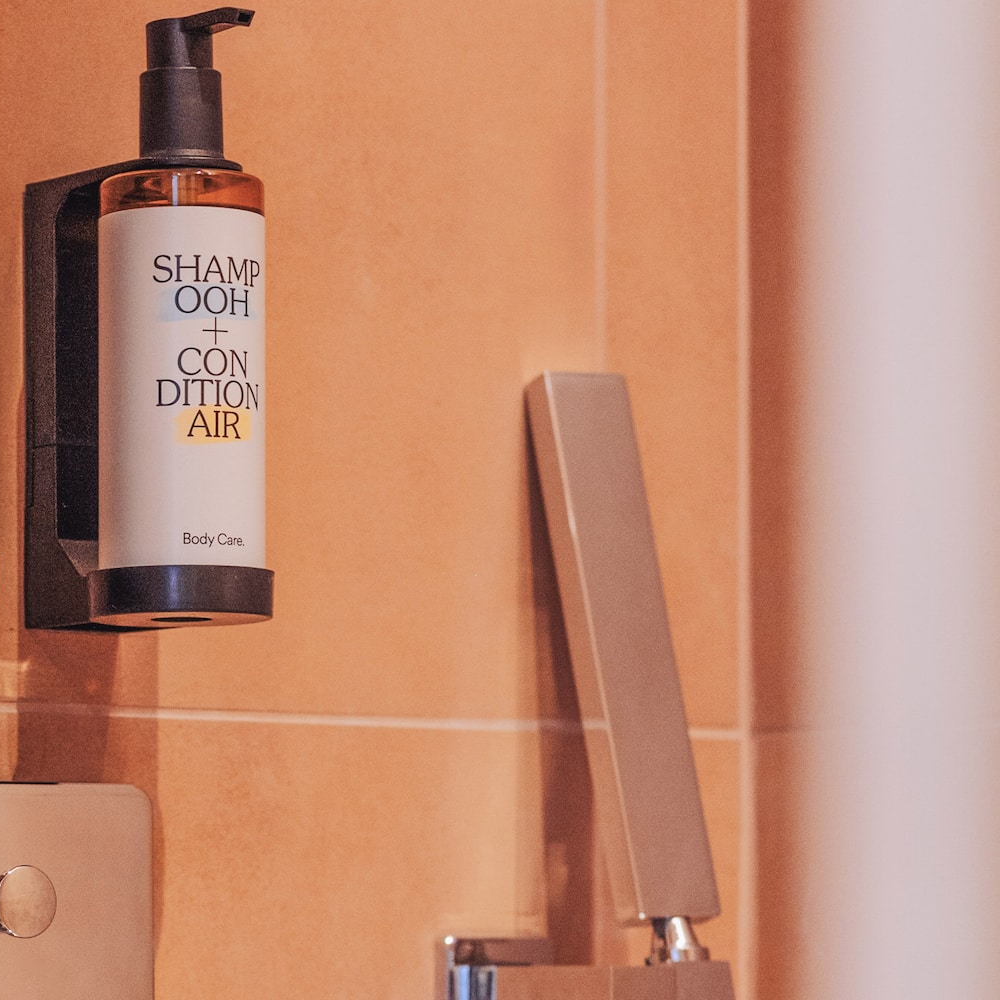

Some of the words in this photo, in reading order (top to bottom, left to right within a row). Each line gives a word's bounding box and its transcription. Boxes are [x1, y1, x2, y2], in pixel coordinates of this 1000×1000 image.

[152, 254, 260, 287] SHAMP
[174, 285, 250, 317] OOH
[177, 347, 248, 379] CON
[155, 378, 259, 411] DITION
[187, 409, 241, 439] AIR
[183, 532, 215, 548] Body
[217, 532, 245, 546] Care.
